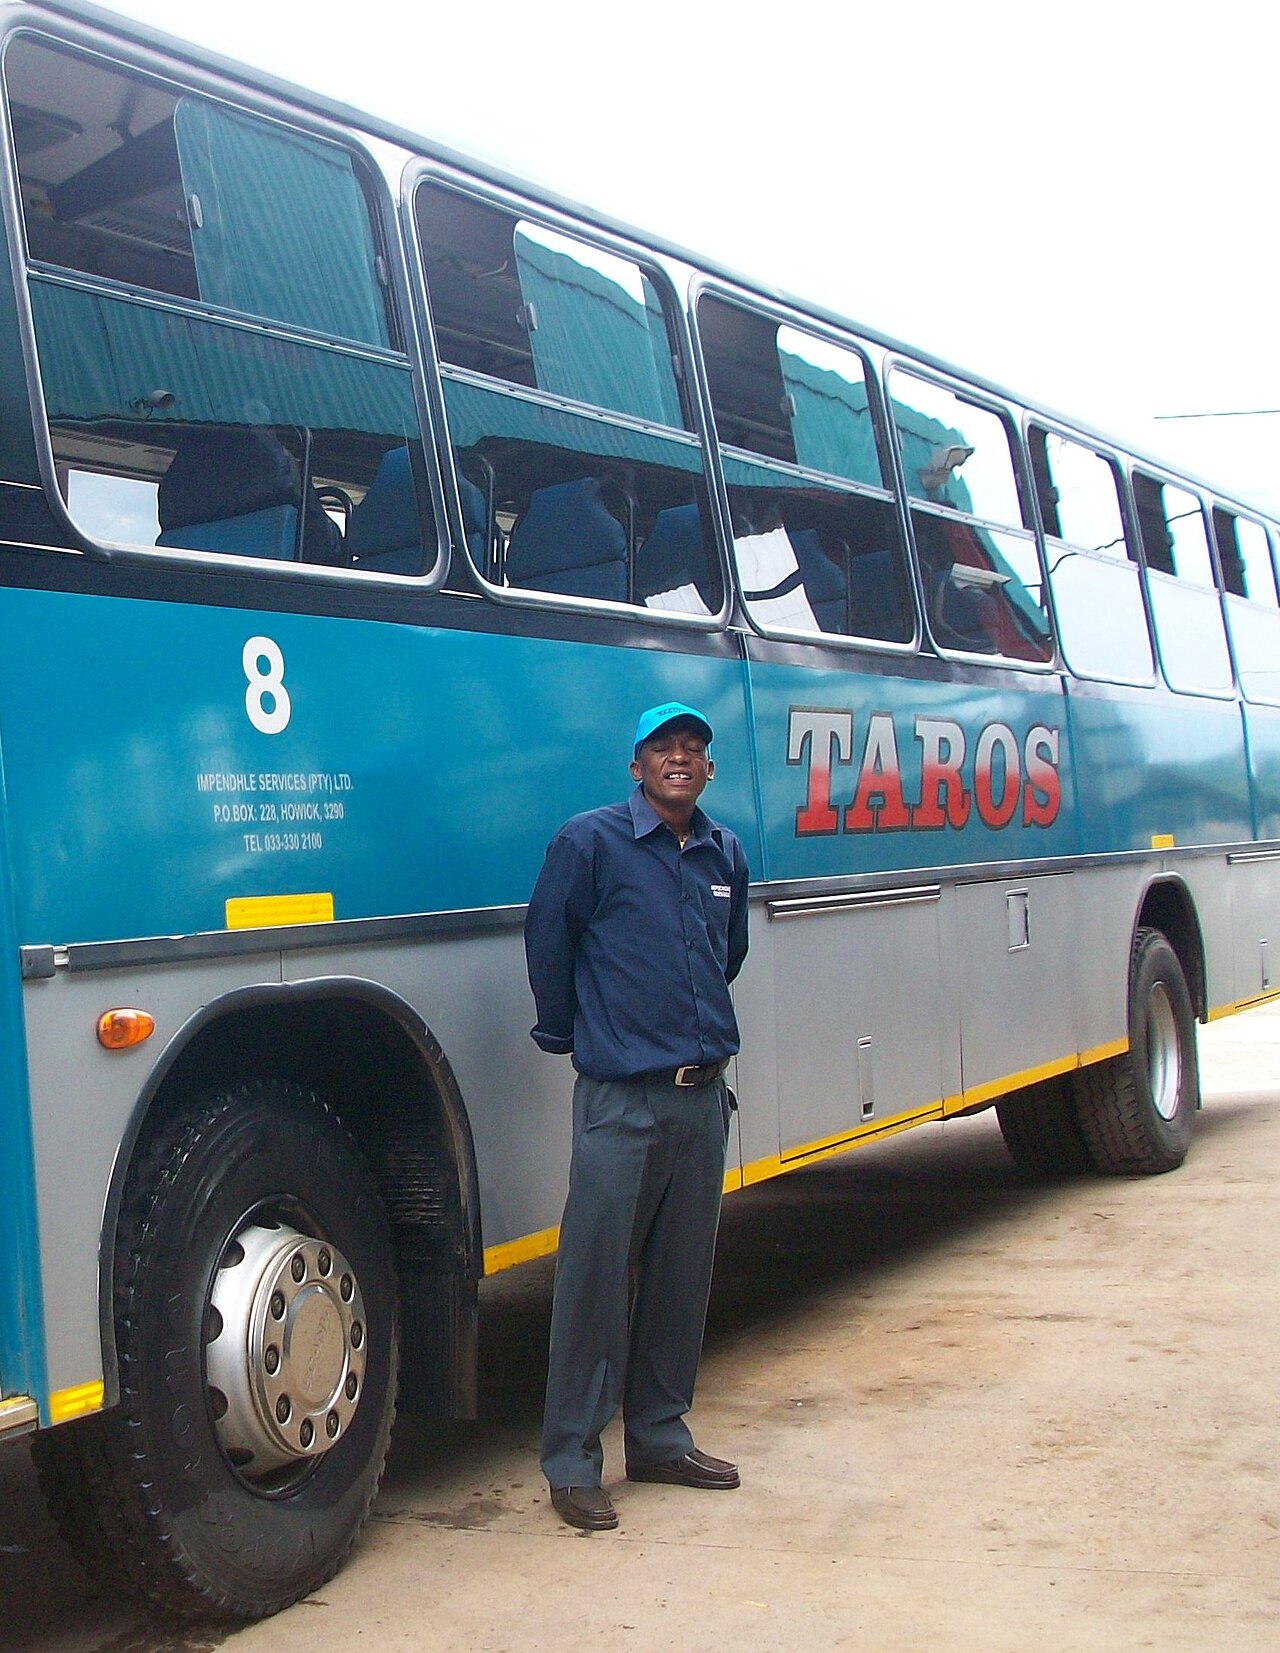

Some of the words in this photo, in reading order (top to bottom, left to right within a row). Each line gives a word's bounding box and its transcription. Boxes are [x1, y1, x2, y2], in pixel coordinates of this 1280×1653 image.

[242, 635, 292, 735] 8
[786, 704, 1062, 838] TAROS
[197, 773, 257, 791] IMPENDHLE
[258, 773, 307, 791] SERVICES
[308, 774, 333, 794] (PTY)
[334, 774, 354, 791] LTD.
[213, 804, 258, 822] P.O.BOX:
[259, 804, 280, 823] 228,
[281, 803, 323, 822] HOWICK,
[323, 802, 344, 820] 3290
[243, 834, 263, 852] TEL
[264, 833, 300, 851] 033-330
[301, 832, 322, 850] 2100
